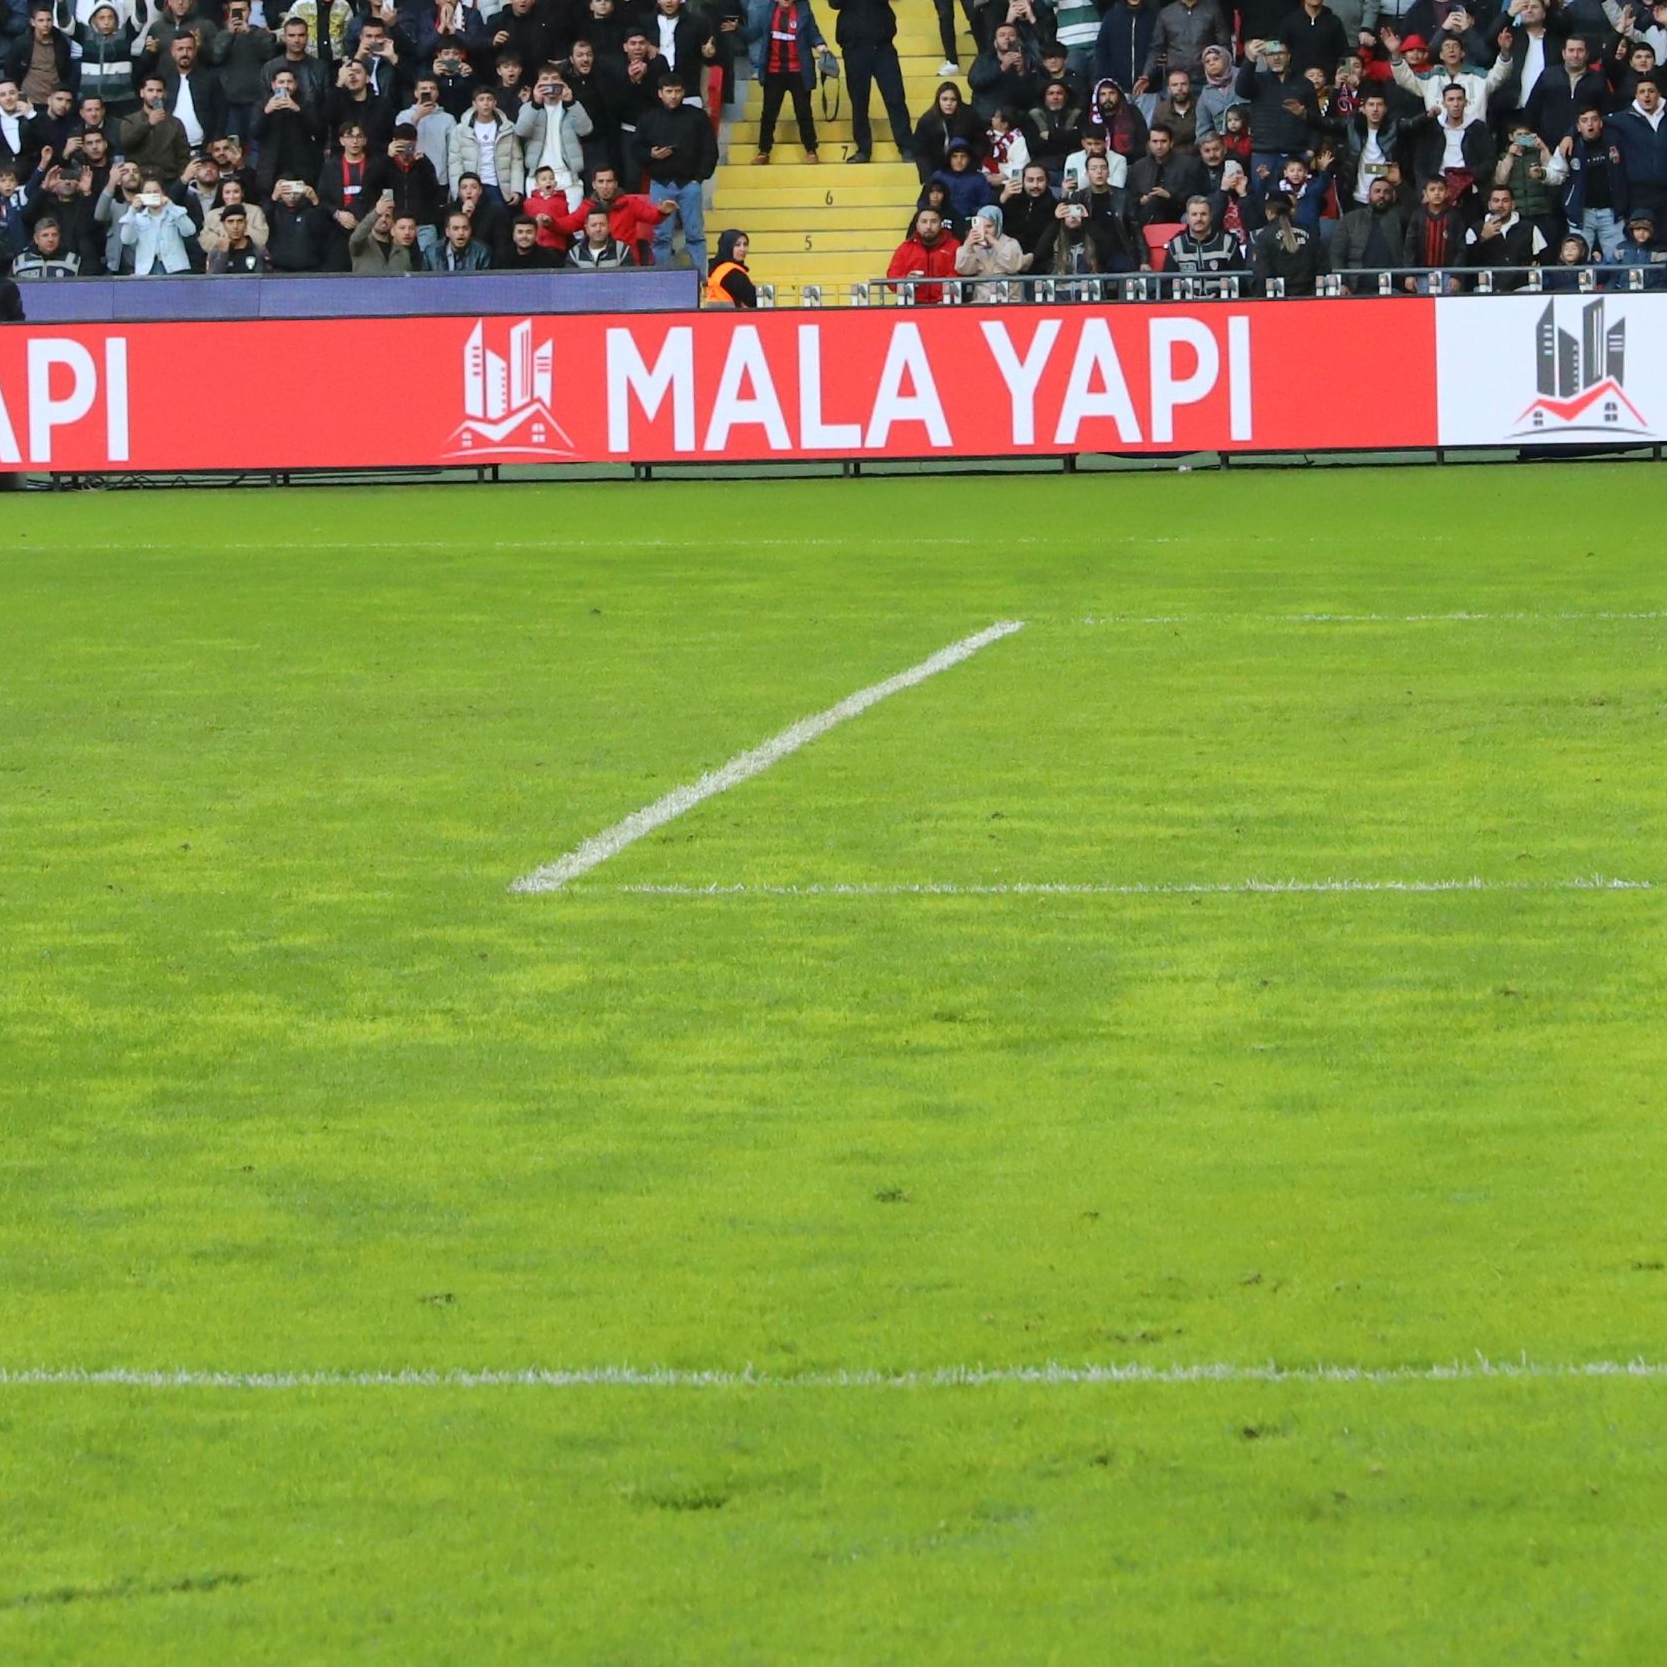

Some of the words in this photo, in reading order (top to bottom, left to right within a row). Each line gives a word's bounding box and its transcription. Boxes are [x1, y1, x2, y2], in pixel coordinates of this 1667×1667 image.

[841, 145, 849, 160] 7
[825, 190, 834, 205] 6
[805, 234, 813, 250] 5
[606, 321, 953, 453] MALA
[980, 315, 1254, 447] YAPI
